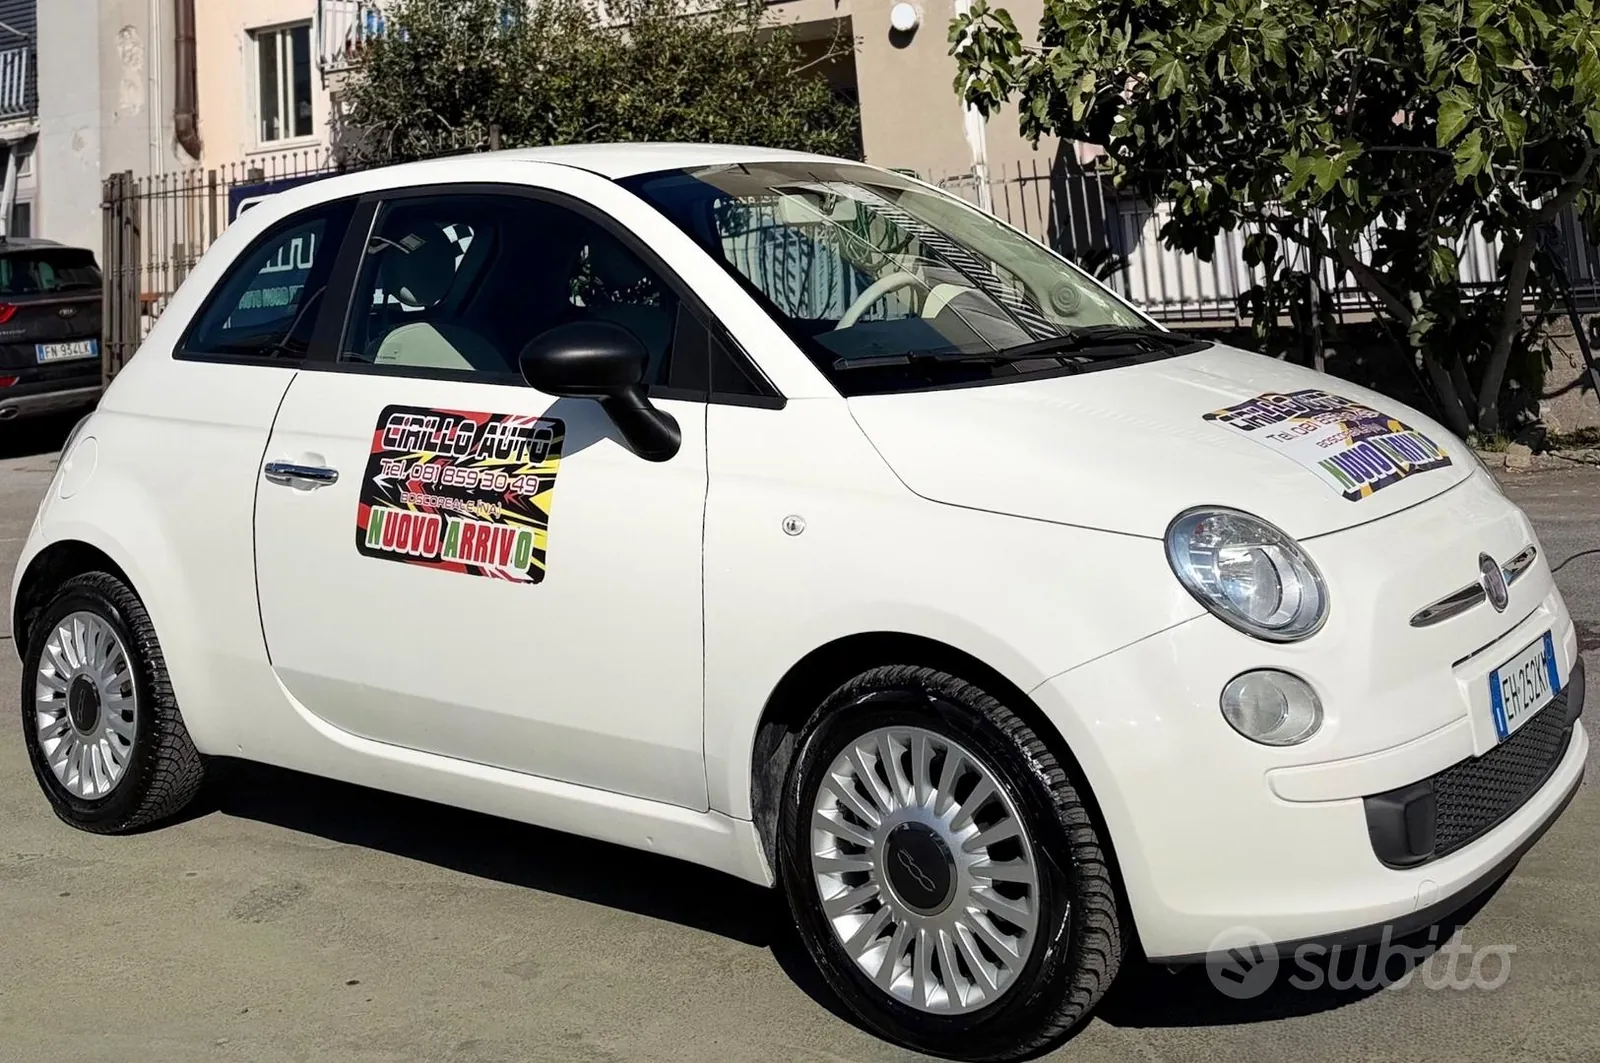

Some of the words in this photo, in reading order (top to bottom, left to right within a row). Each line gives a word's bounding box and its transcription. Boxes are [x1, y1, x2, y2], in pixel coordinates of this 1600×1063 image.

[382, 413, 476, 458] CIRILLO
[476, 421, 554, 464] AUTO
[380, 459, 408, 479] Tel.
[410, 463, 440, 486] 081
[442, 467, 479, 487] 859
[479, 471, 509, 492] 30
[511, 475, 540, 495] 49
[1317, 440, 1398, 493] NUOVO
[400, 492, 475, 513] BOSCOREALE
[365, 505, 442, 558] NUOVO
[441, 516, 534, 572] ARRIVO
